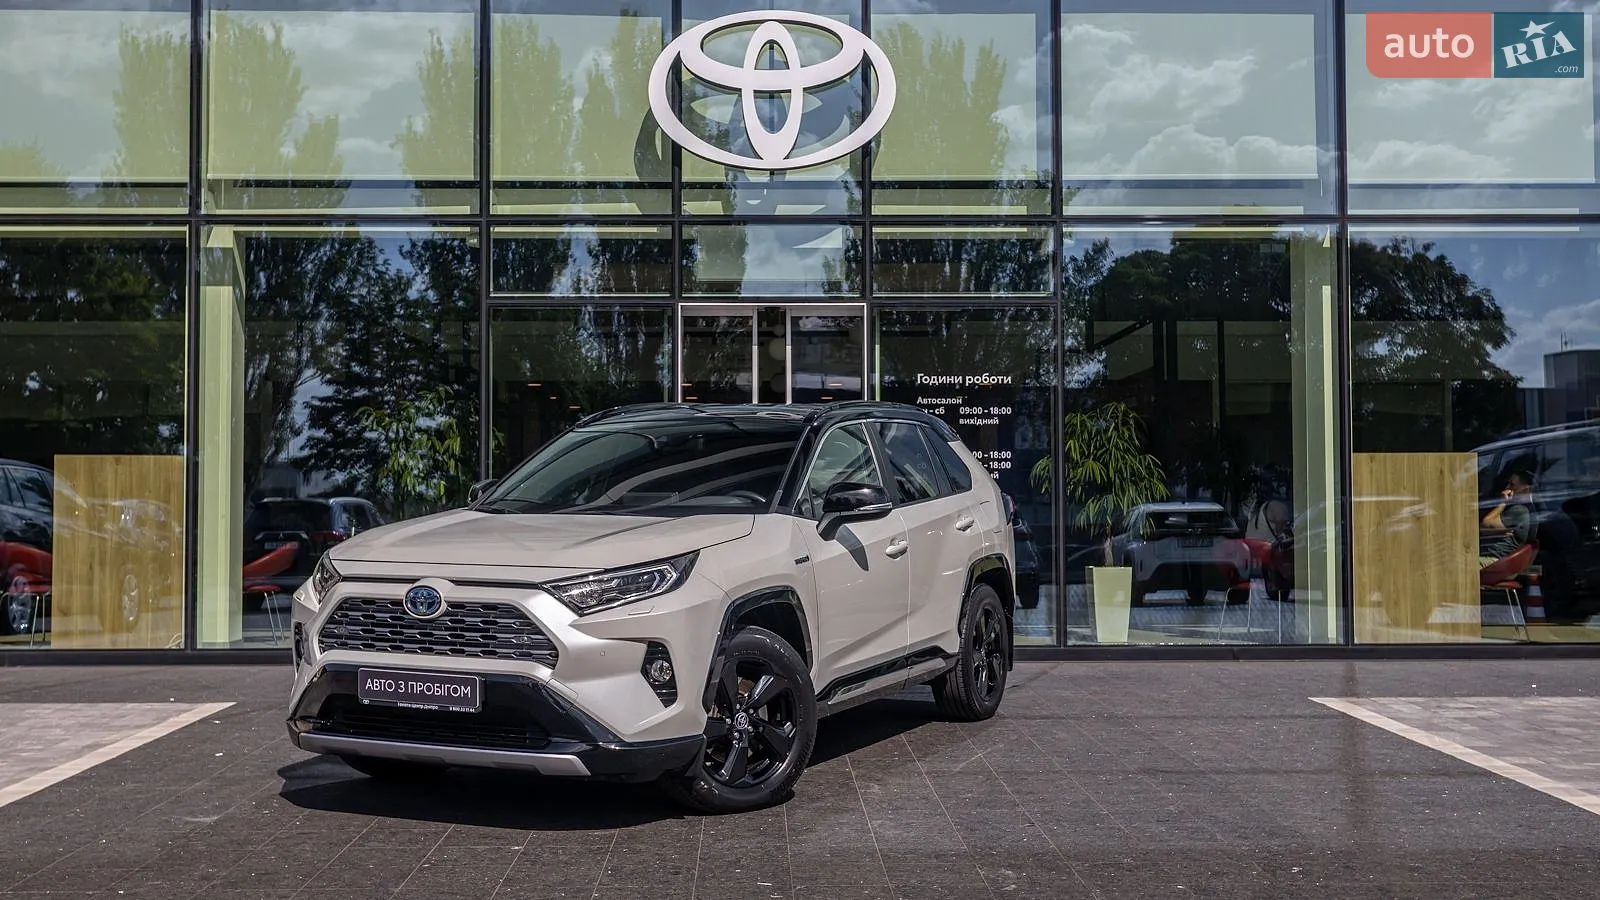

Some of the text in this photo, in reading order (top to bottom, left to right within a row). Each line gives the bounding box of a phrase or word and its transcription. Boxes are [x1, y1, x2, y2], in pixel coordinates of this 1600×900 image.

[917, 372, 1012, 386] Години роботи
[916, 396, 962, 404] Автосалон
[934, 406, 945, 415] сб
[959, 406, 983, 415] 09:00
[990, 406, 1012, 415] 18:00
[959, 416, 999, 426] вихідний
[989, 450, 1012, 459] 18:00
[989, 461, 1012, 469] 18:00
[365, 678, 395, 692] АВТО
[408, 681, 471, 698] ПРОБІГОМ
